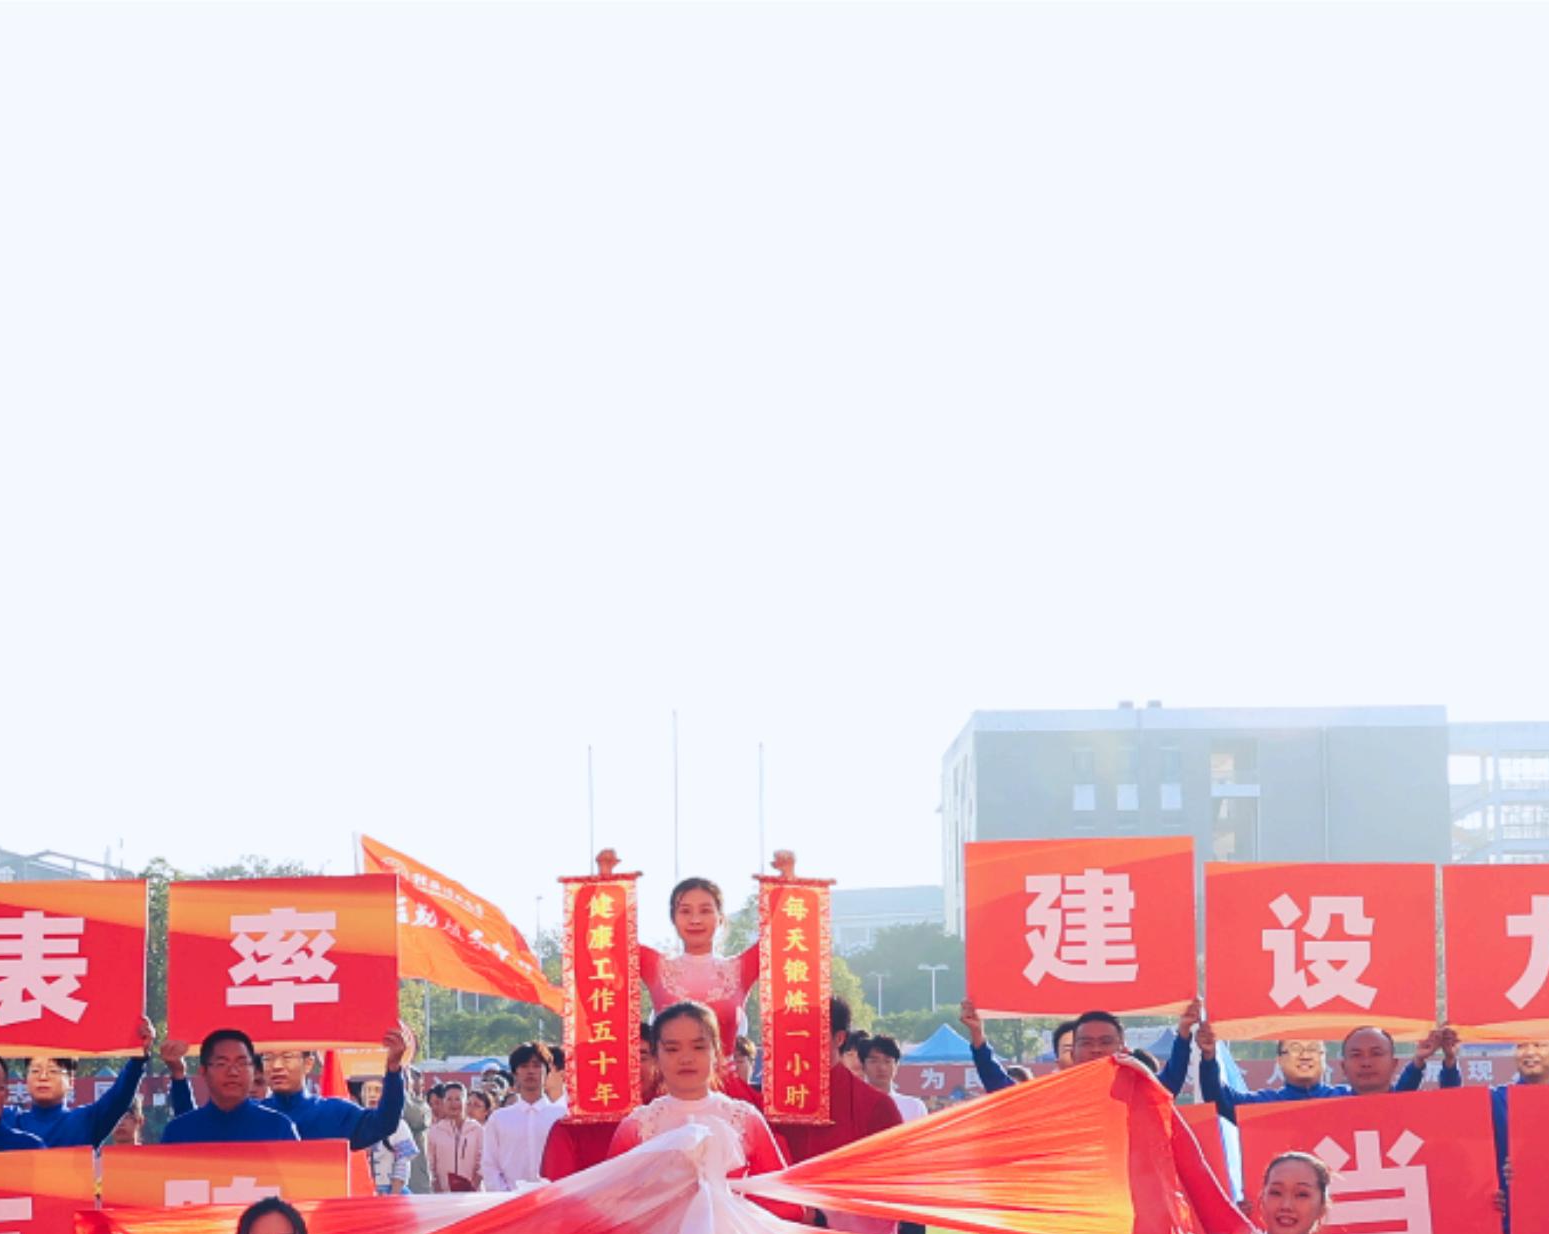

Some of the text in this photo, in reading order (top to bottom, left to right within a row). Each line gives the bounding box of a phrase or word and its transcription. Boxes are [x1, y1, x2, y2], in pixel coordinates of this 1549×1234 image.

[227, 907, 339, 1021] 率
[586, 894, 619, 1107] 健康工作五十年
[781, 896, 812, 1108] 每天锻炼一小时
[1023, 868, 1139, 986] 建
[1262, 893, 1377, 1009] 设
